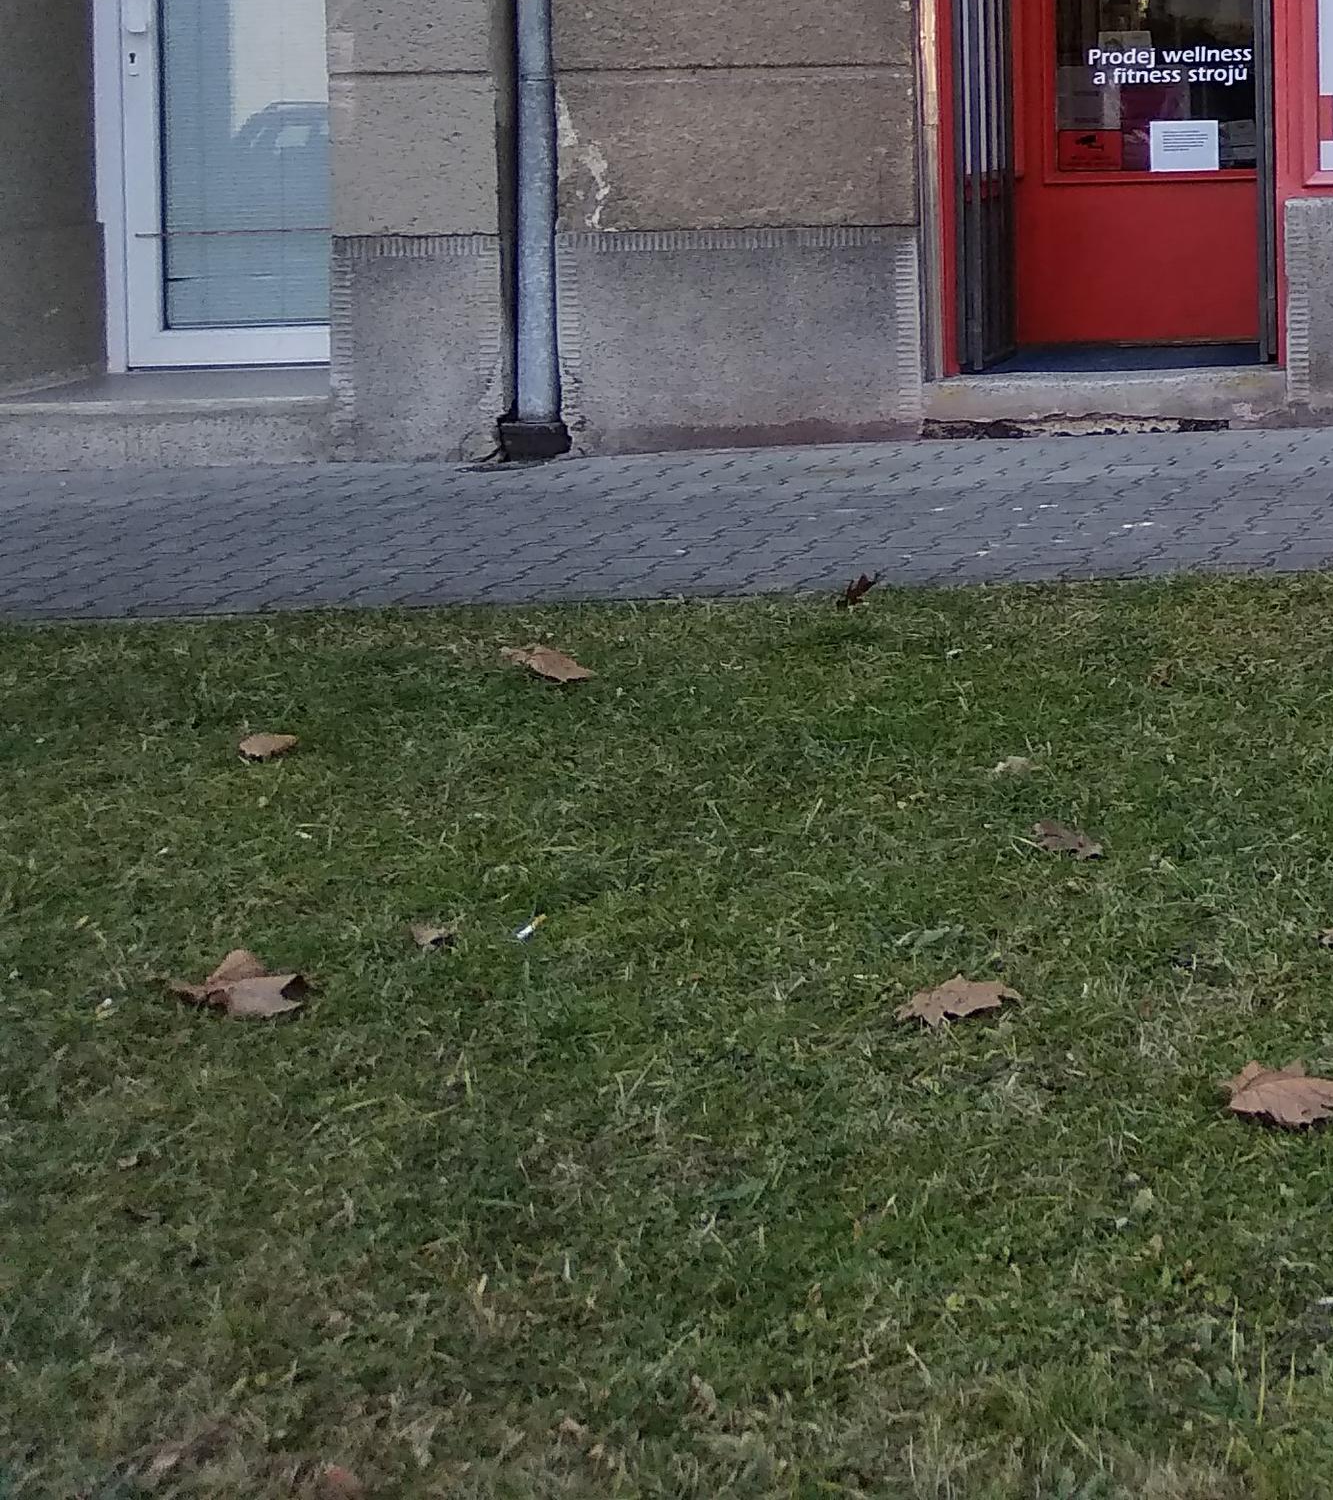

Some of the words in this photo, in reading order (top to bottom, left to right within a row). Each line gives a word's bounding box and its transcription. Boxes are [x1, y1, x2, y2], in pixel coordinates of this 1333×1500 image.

[1088, 47, 1156, 69] Prodej
[1162, 46, 1253, 63] wellness
[1093, 71, 1106, 85] a
[1113, 66, 1182, 85] fitness
[1187, 64, 1248, 87] strojů
